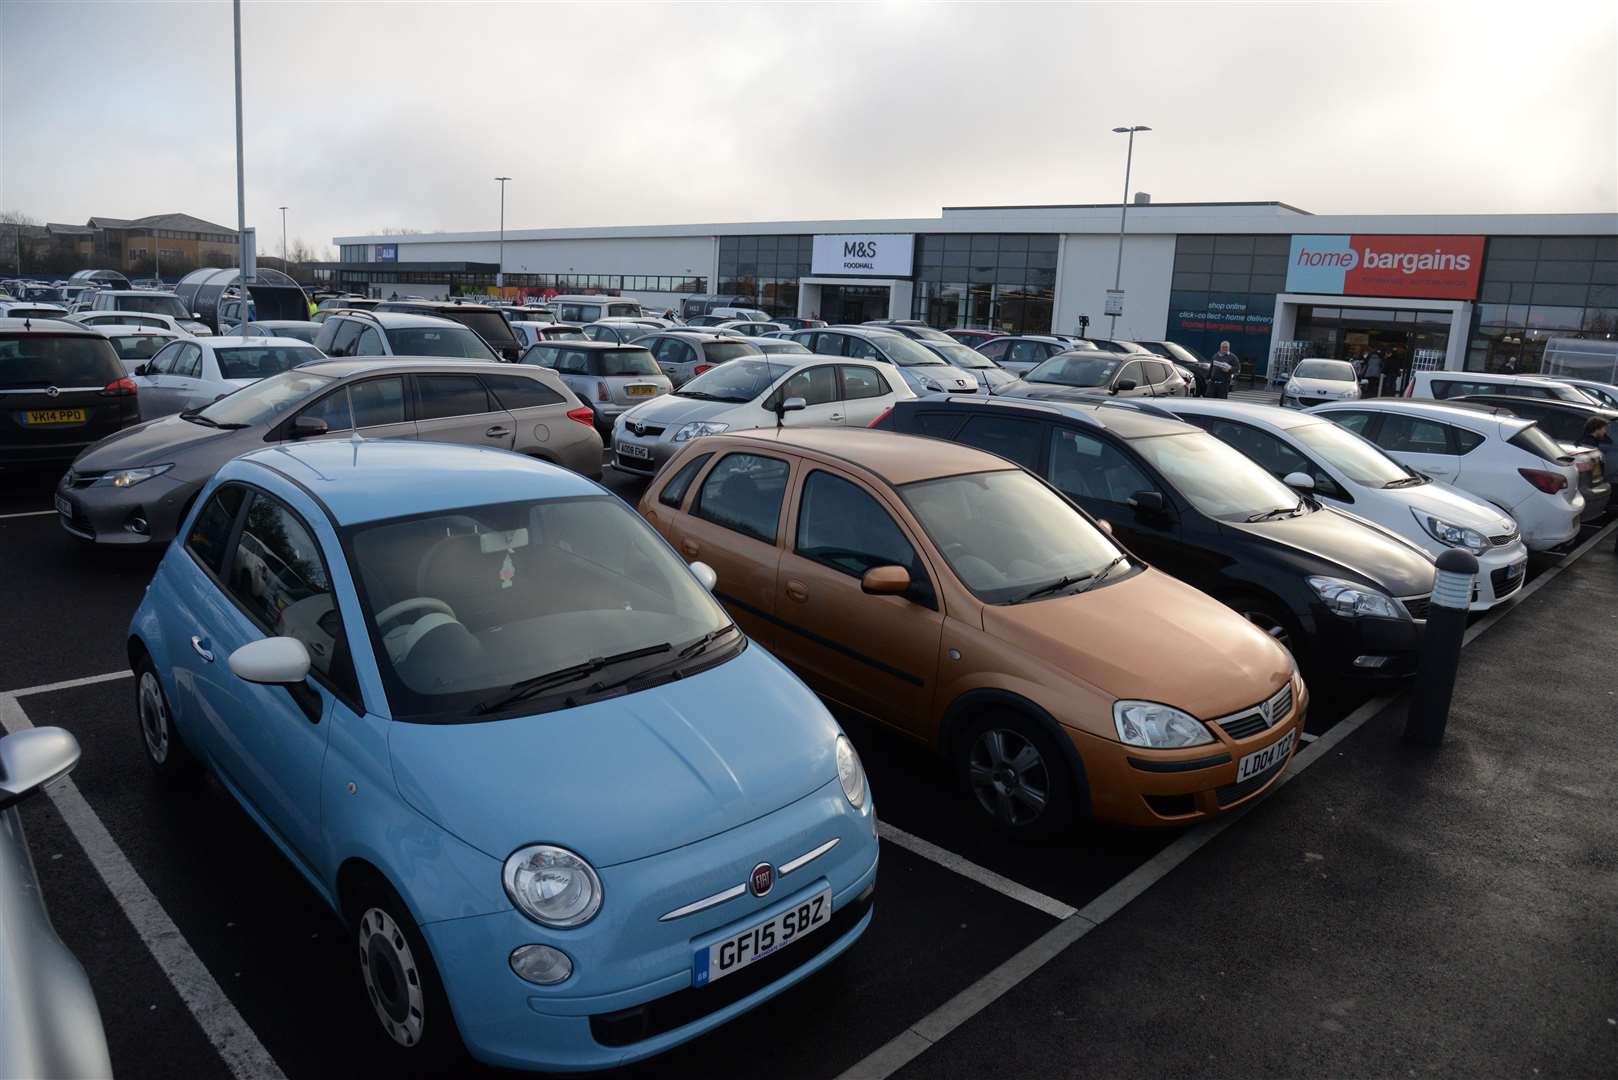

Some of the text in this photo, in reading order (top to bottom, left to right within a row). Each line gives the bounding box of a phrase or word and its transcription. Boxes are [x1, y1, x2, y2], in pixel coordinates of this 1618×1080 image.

[843, 241, 877, 258] M&S
[1296, 248, 1471, 274] home bargains
[1208, 302, 1225, 310] shop
[1246, 315, 1273, 324] delivery
[1243, 746, 1275, 777] LD04
[755, 871, 770, 889] FIAT
[719, 921, 776, 970] GF15
[782, 895, 825, 940] SBZ
